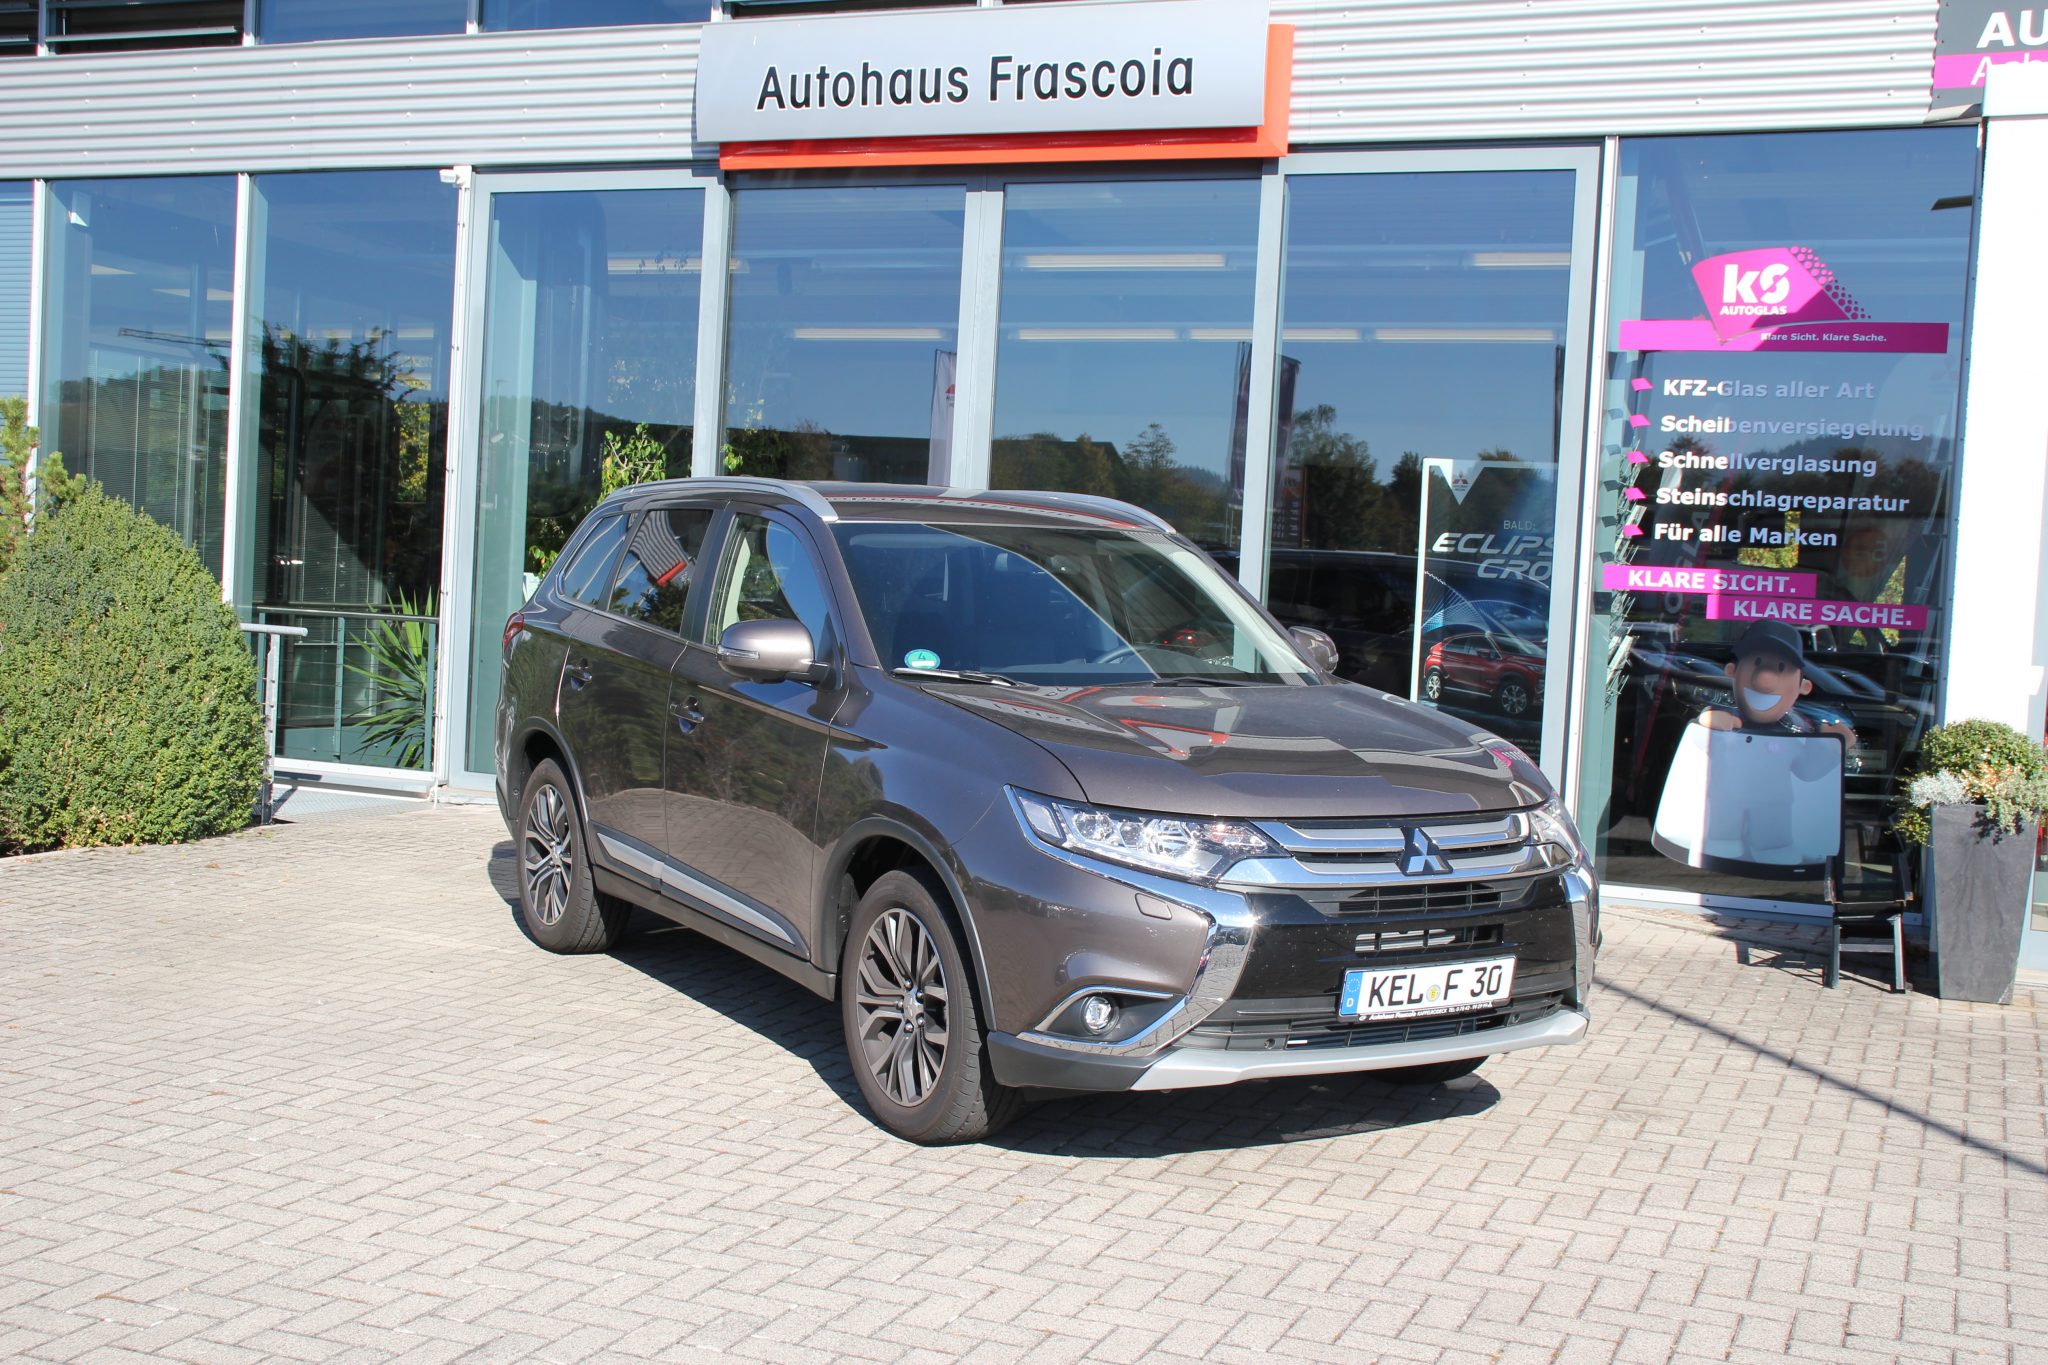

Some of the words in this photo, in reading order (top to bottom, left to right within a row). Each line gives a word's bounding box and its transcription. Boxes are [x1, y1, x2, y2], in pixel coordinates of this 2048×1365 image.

[755, 61, 970, 112] Autohaus
[988, 46, 1194, 102] Frascoia
[1719, 305, 1788, 316] AUTOGLAS
[1760, 332, 1788, 342] Klare
[1790, 332, 1820, 342] Sicht.
[1822, 333, 1850, 342] Klare
[1852, 333, 1887, 342] Sache.
[1663, 378, 1768, 398] KFZ-Glas
[1775, 381, 1830, 399] aller
[1836, 382, 1876, 399] Art
[1660, 414, 1926, 441] Scheibenversiegelung
[1657, 450, 1878, 477] Schnellverglasung
[1655, 487, 1911, 513] Steinschlagreparatur
[1503, 520, 1537, 531] BALD:
[1654, 522, 1694, 542] Für
[1699, 524, 1742, 543] alle
[1749, 527, 1838, 547] Marken
[1628, 569, 1706, 590] KLARE
[1712, 573, 1797, 593] SICHT.
[1733, 600, 1813, 621] KLARE
[1820, 605, 1912, 626] SACHE.
[1368, 973, 1424, 1008] KEL
[1443, 969, 1464, 1001] F
[1470, 965, 1503, 998] 30
[1346, 997, 1354, 1007] D
